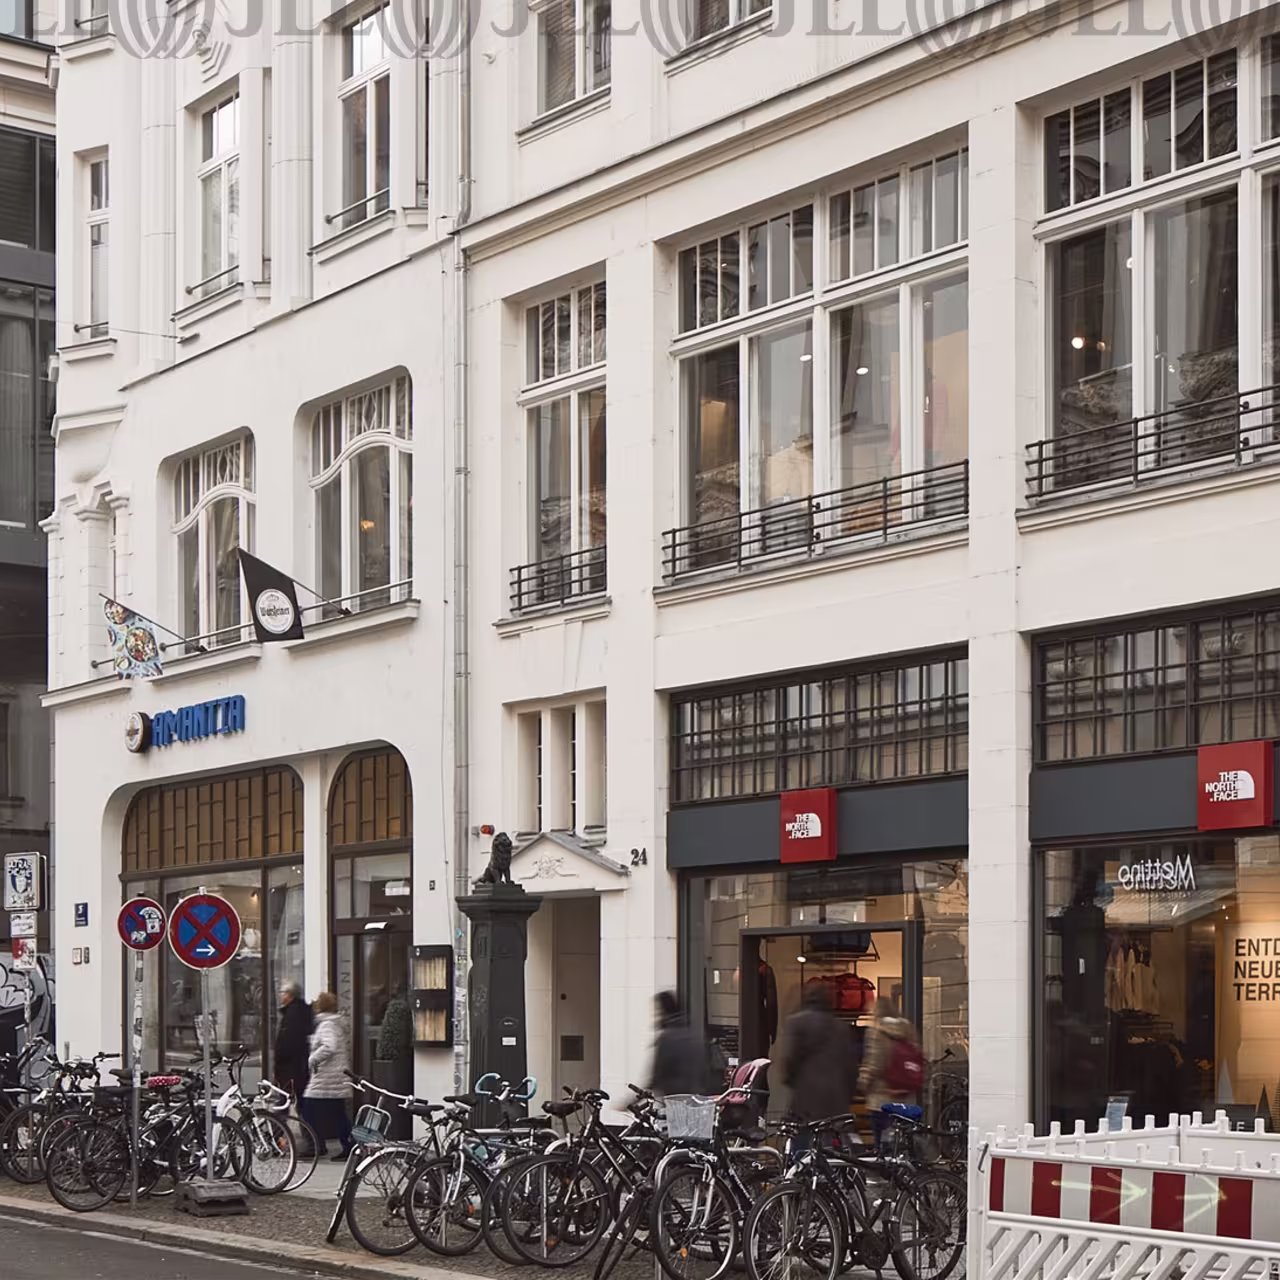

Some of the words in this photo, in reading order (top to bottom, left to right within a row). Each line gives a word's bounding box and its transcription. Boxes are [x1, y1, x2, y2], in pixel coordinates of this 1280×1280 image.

[1218, 771, 1239, 782] THE
[1205, 781, 1237, 793] NORTH
[795, 814, 810, 824] THE
[786, 822, 810, 832] NORTH
[631, 847, 648, 866] 24
